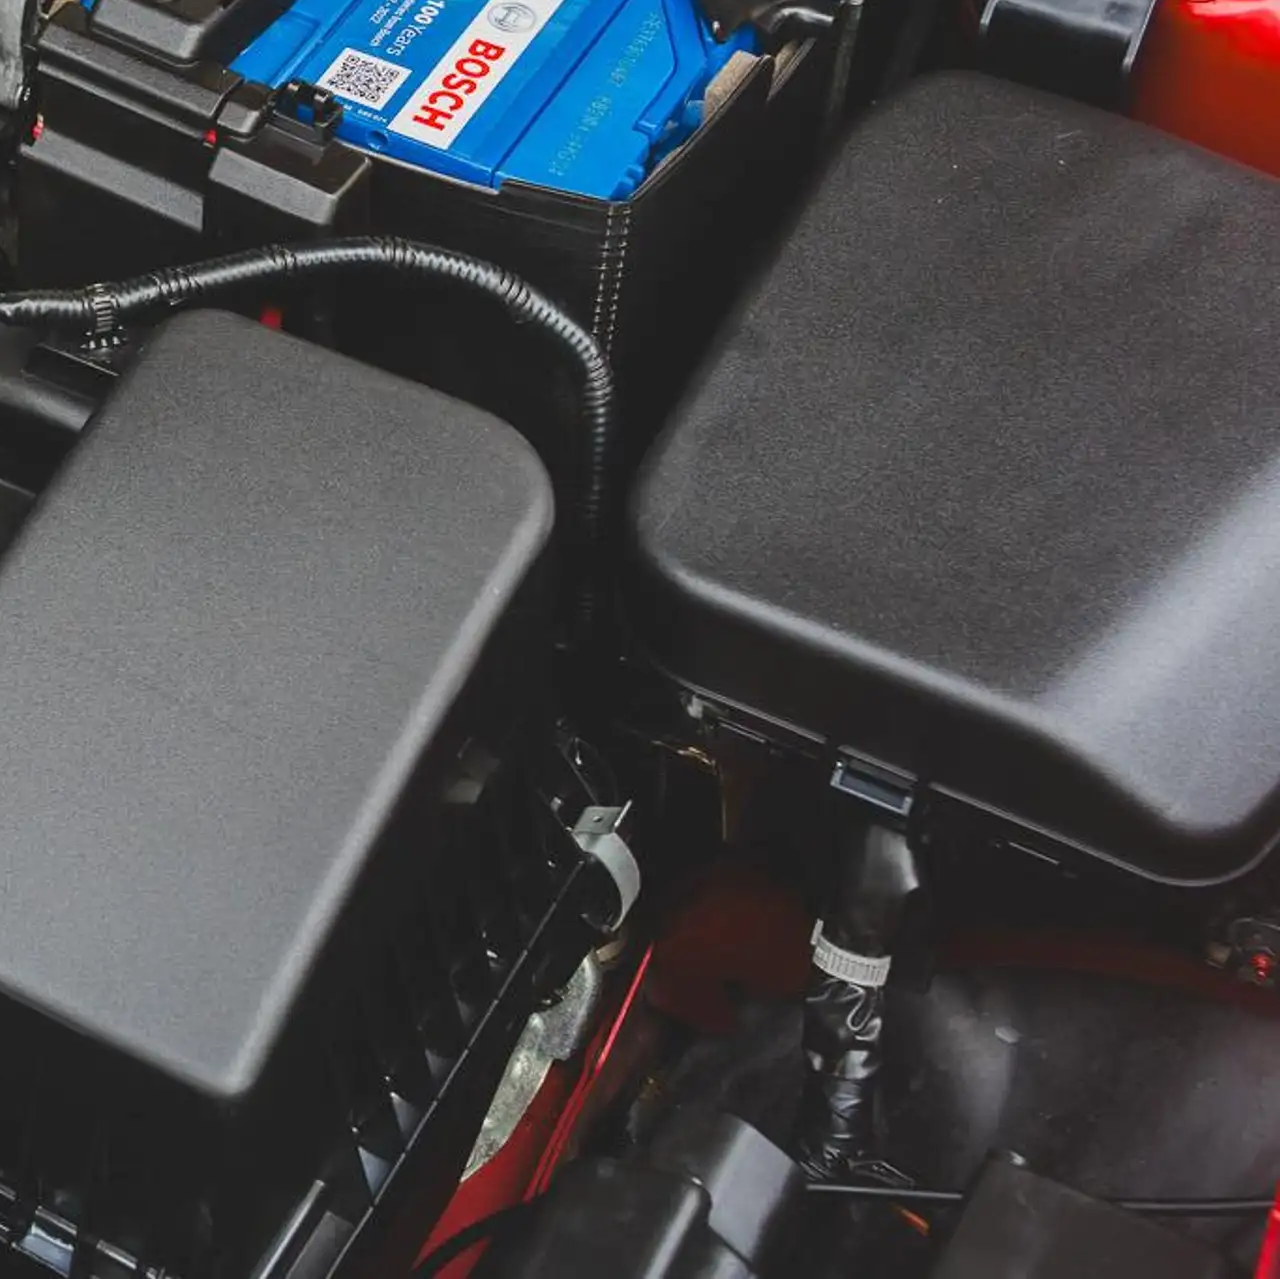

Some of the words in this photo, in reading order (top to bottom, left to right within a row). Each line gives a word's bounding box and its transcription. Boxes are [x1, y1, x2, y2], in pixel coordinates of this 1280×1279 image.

[413, 0, 446, 25] 100
[385, 24, 427, 57] Years
[412, 38, 506, 132] BOSCH
